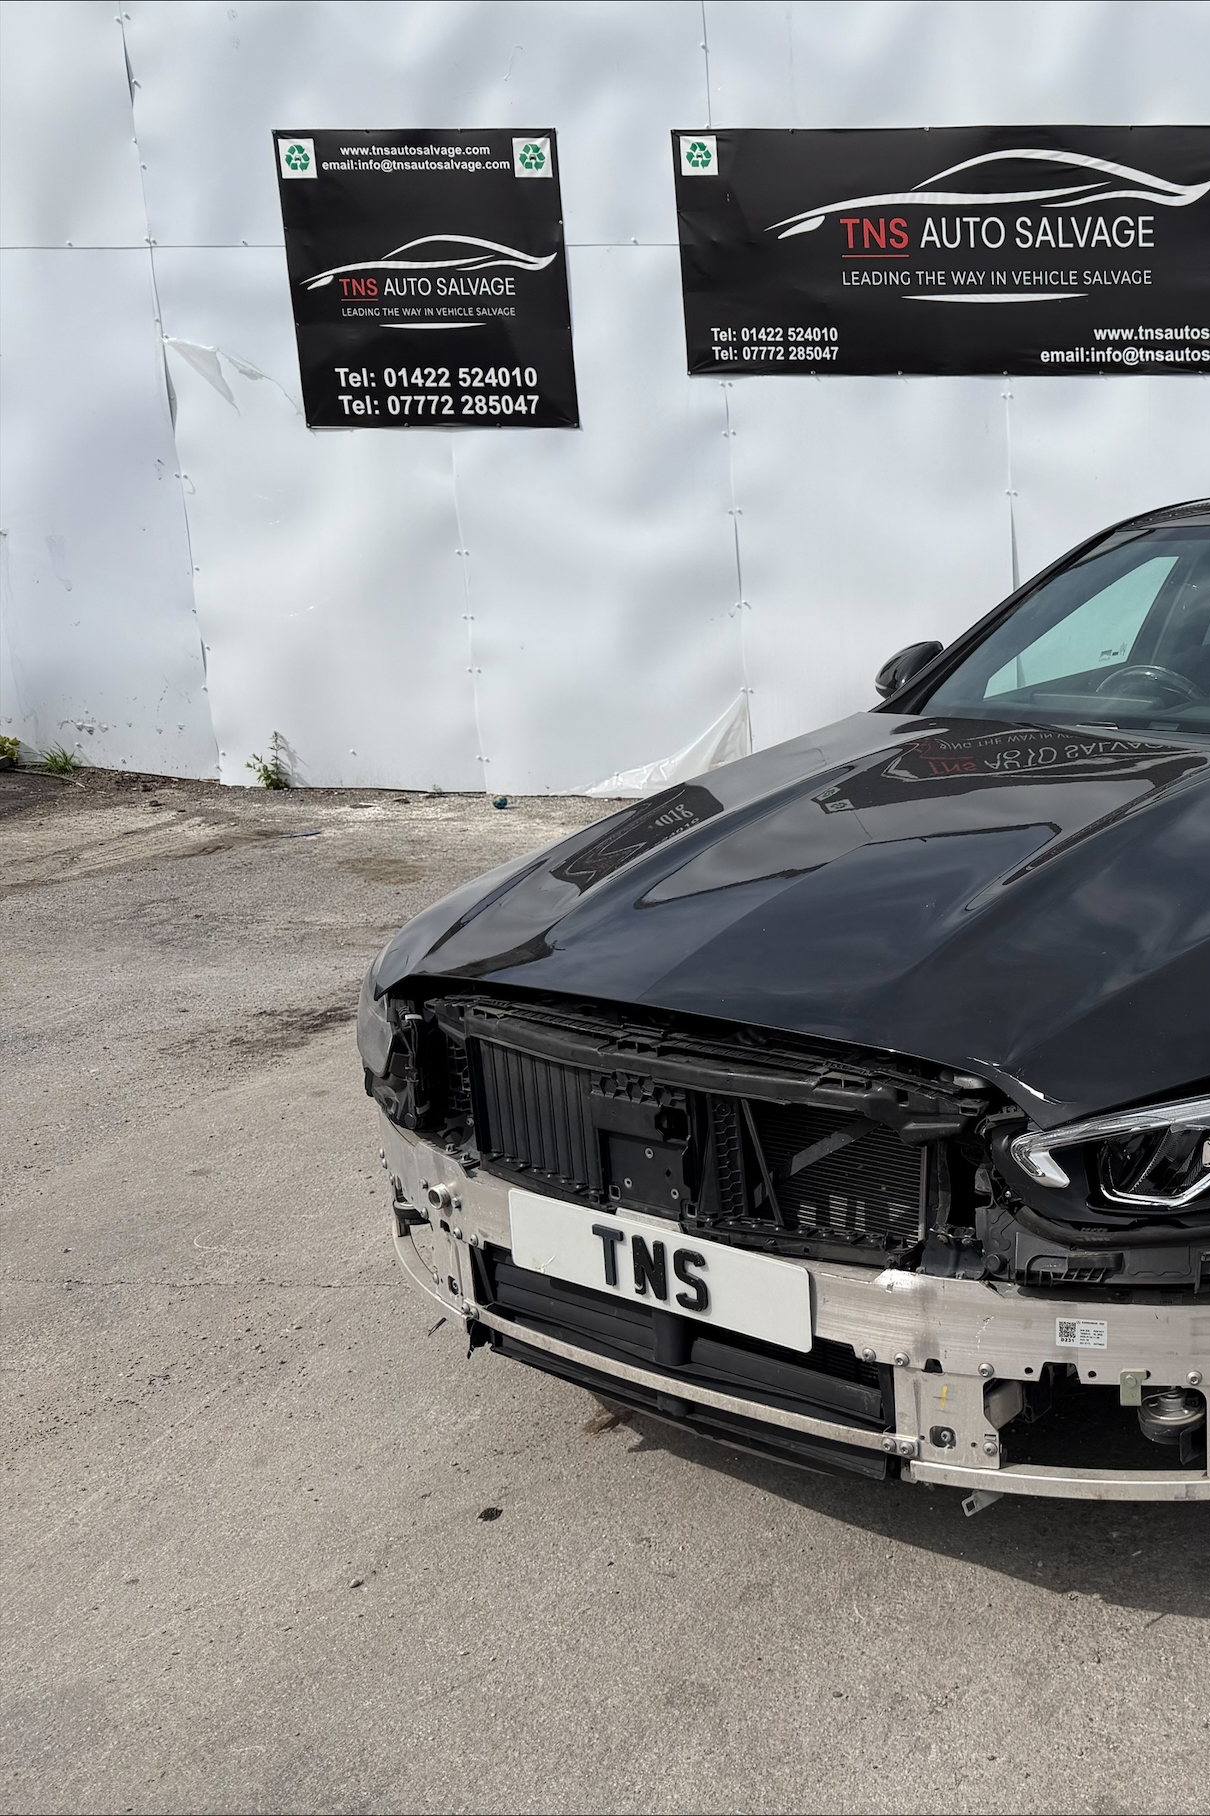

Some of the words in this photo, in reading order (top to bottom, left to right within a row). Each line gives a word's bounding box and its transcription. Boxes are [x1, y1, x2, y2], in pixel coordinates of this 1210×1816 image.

[340, 145, 490, 158] www.tnsautosalvage.com
[322, 159, 510, 172] email:info@tnsautosalvage.com
[840, 218, 909, 249] TNS
[920, 217, 1005, 248] AUTO
[1015, 216, 1154, 248] SALVAGE
[843, 271, 910, 285] LEADING
[915, 271, 946, 285] THE
[951, 271, 985, 285] WAY
[991, 271, 1006, 285] IN
[1012, 271, 1078, 285] VEHICLE
[1083, 270, 1152, 285] SALVAGE
[339, 278, 378, 296] TNS
[384, 278, 431, 296] AUTO
[437, 277, 516, 296] SALVAGE
[342, 308, 380, 316] LEADING
[382, 308, 399, 316] THE
[402, 308, 421, 316] WAY
[424, 308, 433, 316] IN
[436, 307, 473, 316] VEHICLE
[476, 307, 515, 316] SALVAGE
[711, 328, 736, 341] Tel:
[741, 327, 783, 341] 01422
[788, 327, 838, 341] 524010
[712, 346, 738, 360] Tel:
[743, 346, 784, 360] 07772
[789, 346, 839, 360] 285047
[334, 368, 376, 387] Tel:
[384, 368, 451, 387] 01422
[459, 367, 537, 387] 524010
[338, 395, 379, 415] Tel:
[387, 395, 454, 415] 07772
[461, 395, 539, 415] 285047
[592, 1223, 709, 1312] TNS
